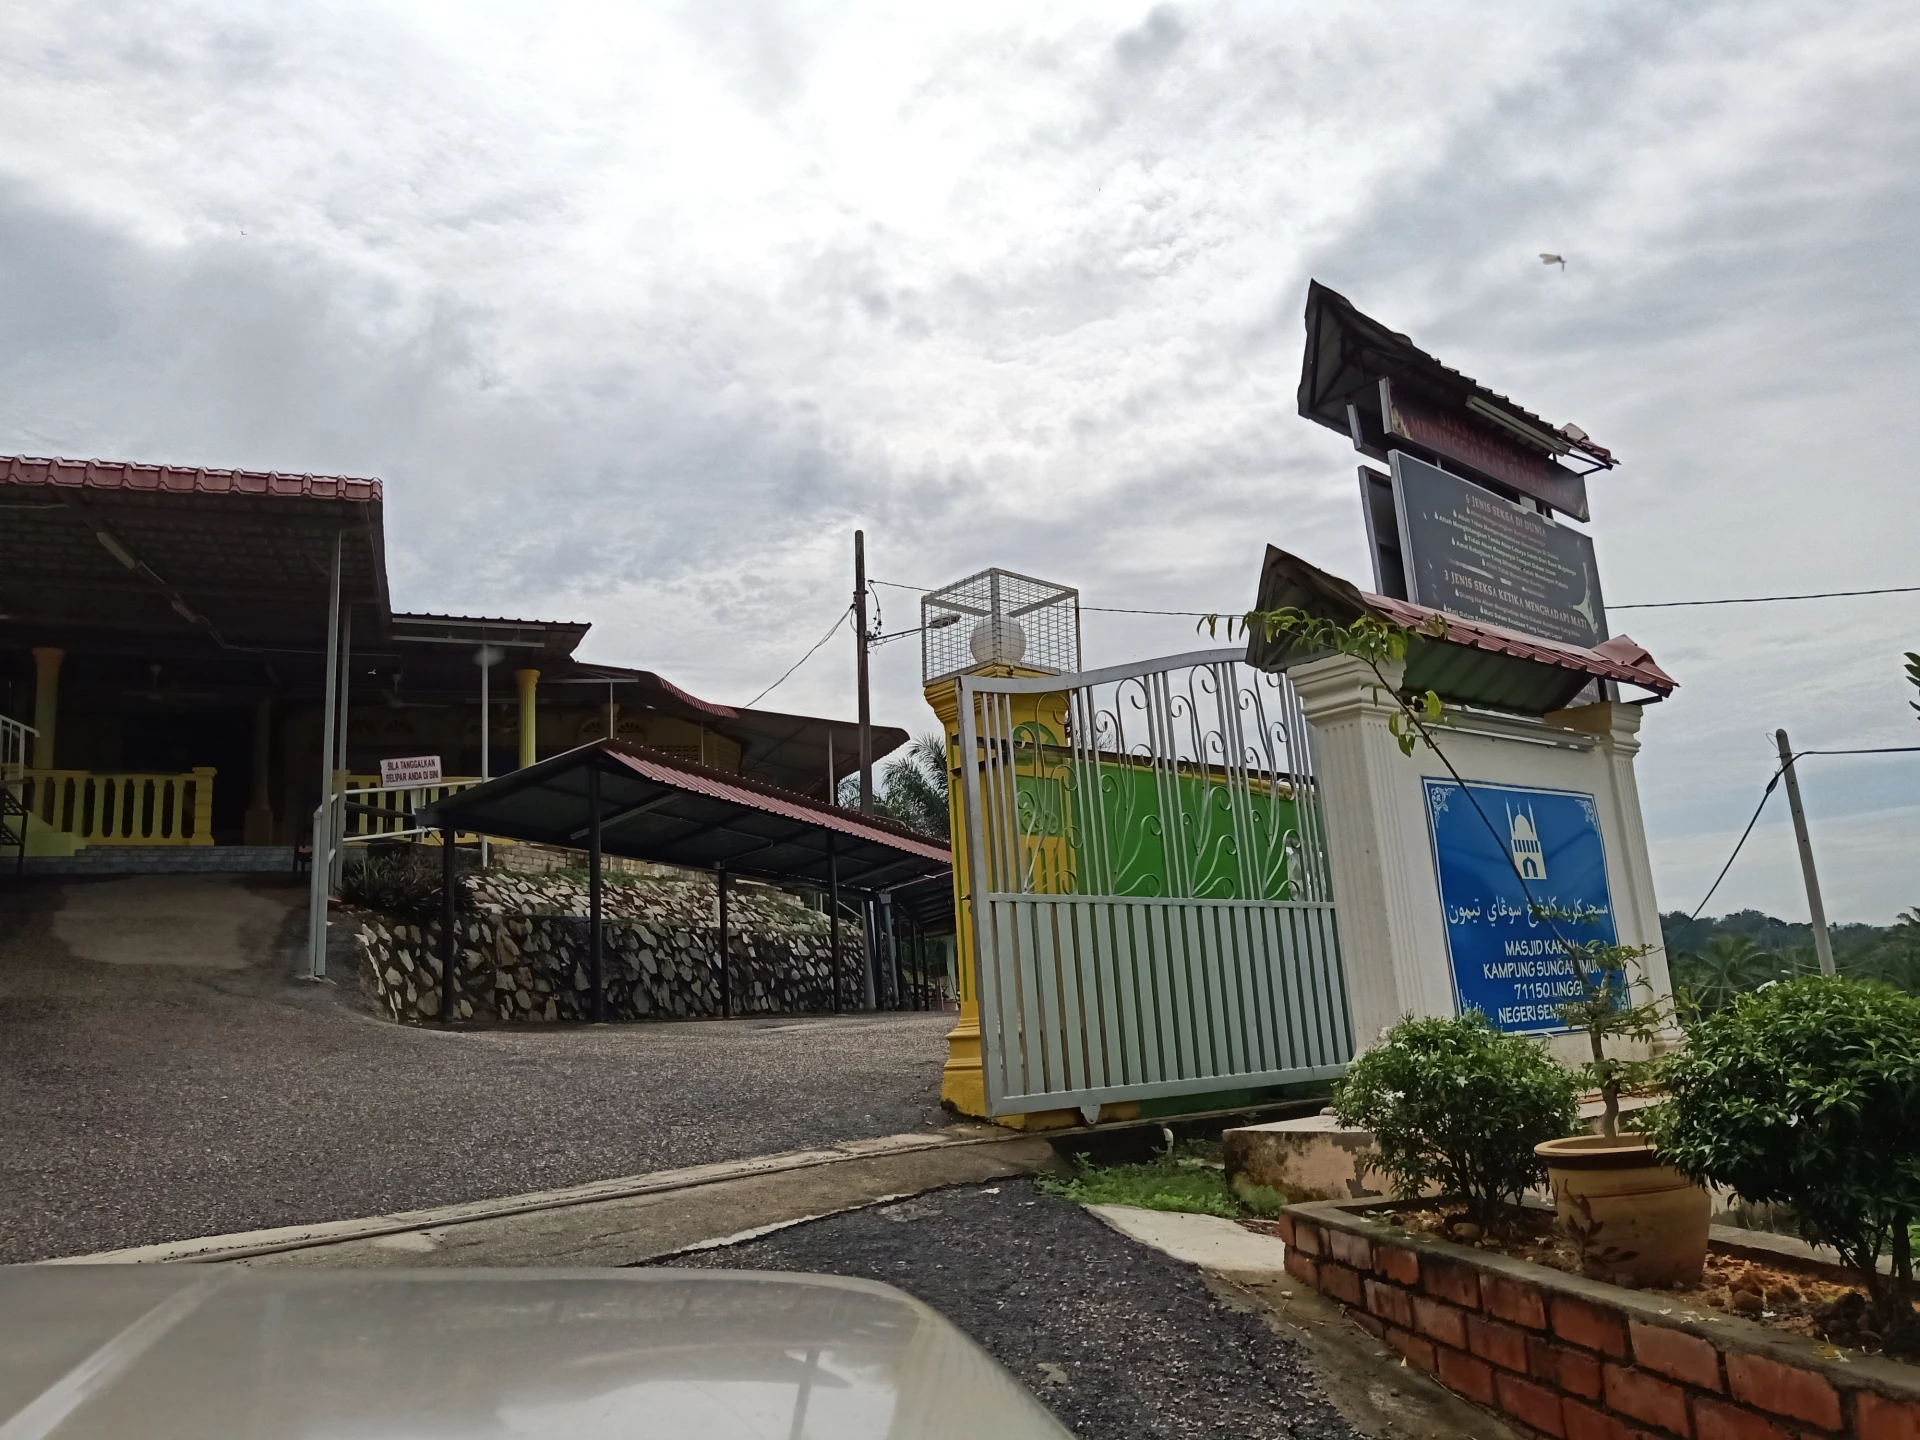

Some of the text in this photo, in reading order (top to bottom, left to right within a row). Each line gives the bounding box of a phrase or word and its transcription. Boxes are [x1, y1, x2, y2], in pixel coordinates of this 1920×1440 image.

[1472, 496, 1491, 513] JENIS
[1492, 506, 1514, 524] SEKSA
[1515, 516, 1523, 528] DI
[1524, 520, 1546, 537] DUNIA
[1444, 570, 1588, 629] 3 JENIS SEKSA KETIKA MENGHADAPI MATI
[387, 759, 436, 771] SILA TANGGALKAN
[385, 770, 439, 783] SELIPAR ANDA DI SINI
[1505, 939, 1543, 956] MASJID
[1482, 961, 1536, 979] KAMPUNG
[1513, 980, 1584, 1000] 71150 LINGGI
[1498, 1004, 1537, 1024] NEGERI
